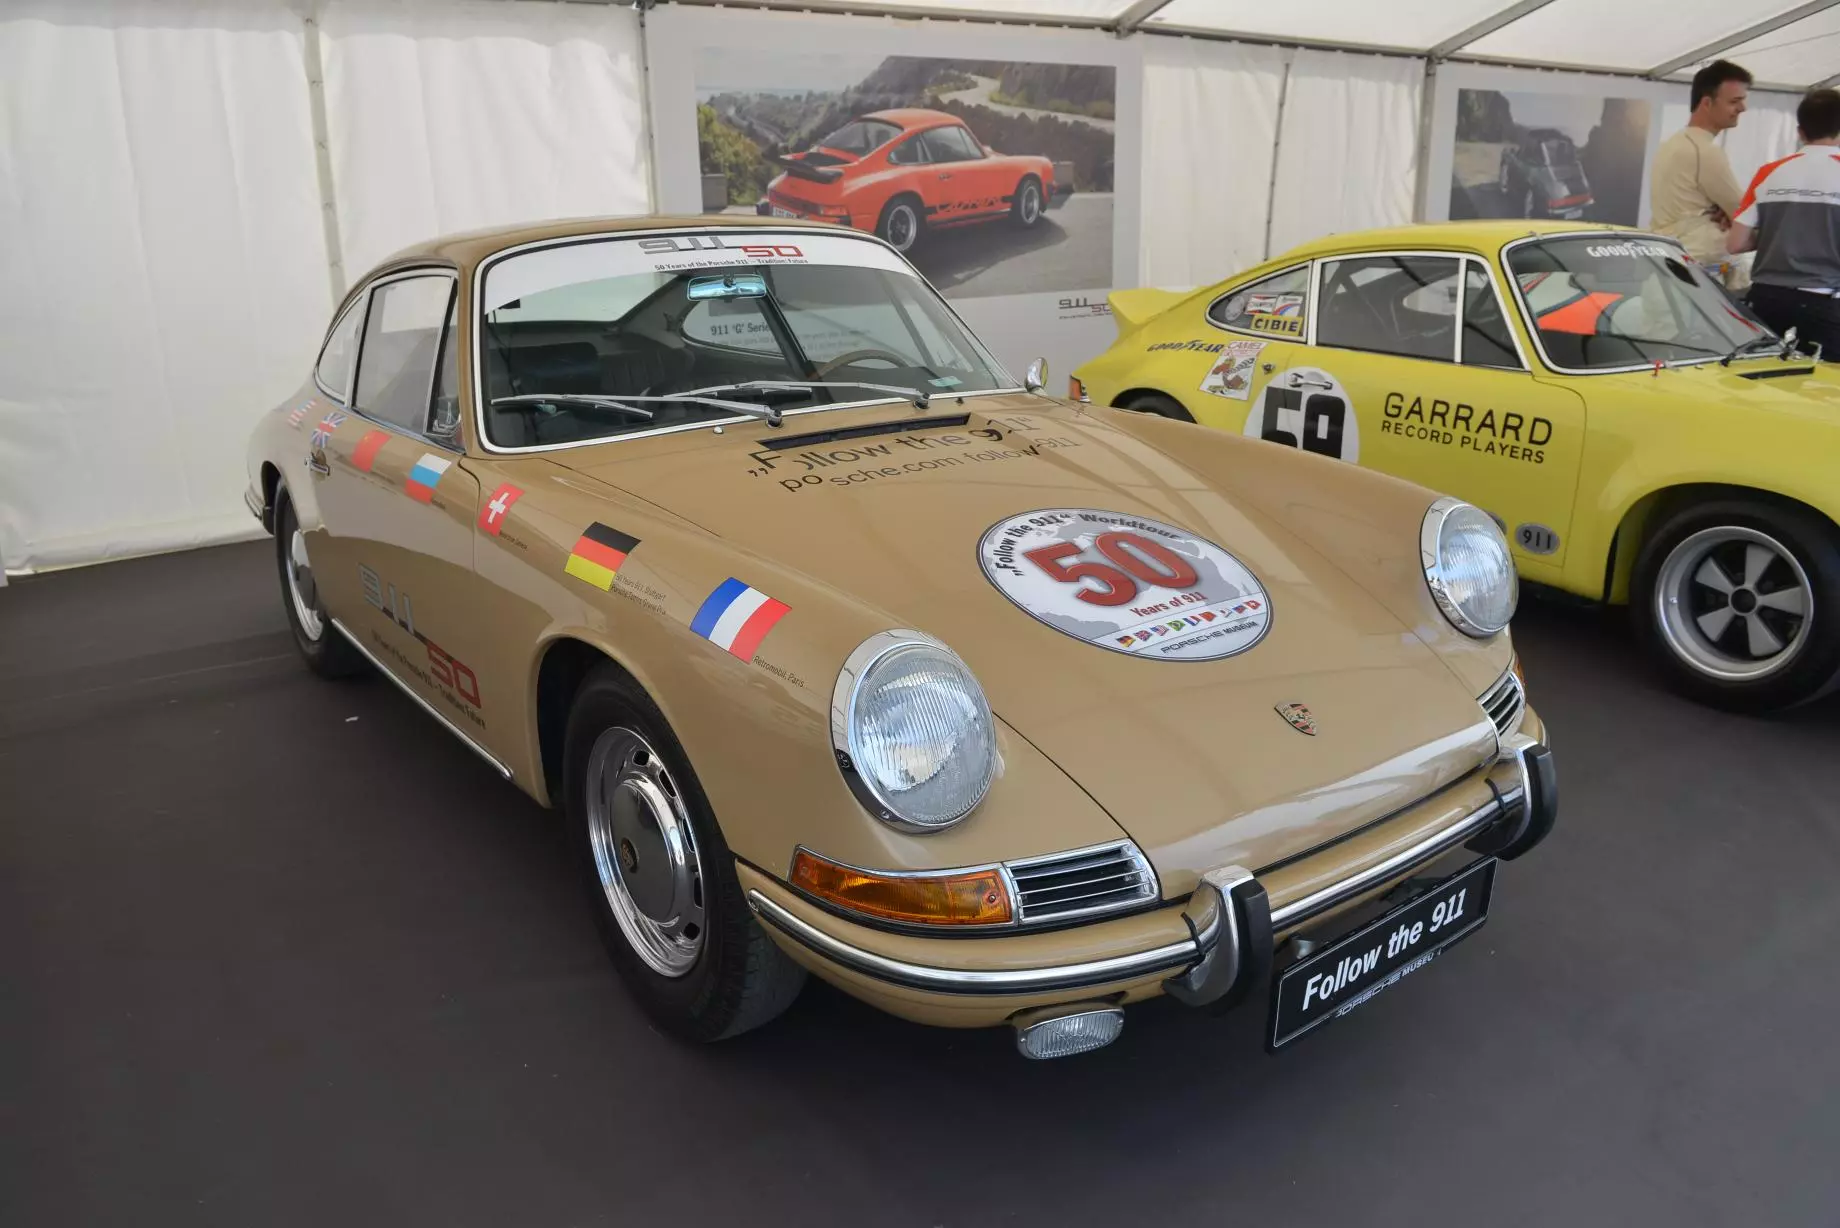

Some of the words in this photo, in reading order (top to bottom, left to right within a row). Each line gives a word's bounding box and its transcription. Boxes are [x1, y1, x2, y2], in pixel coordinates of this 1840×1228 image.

[638, 236, 726, 254] 911
[741, 246, 804, 258] 50
[696, 260, 707, 268] the
[708, 259, 735, 267] Porsche
[710, 322, 729, 336] 911
[1254, 317, 1298, 332] CIBIE
[1384, 392, 1552, 446] GARRARD
[895, 432, 972, 451] the
[1381, 420, 1453, 445] RECORD
[1460, 435, 1544, 464] PLAYERS
[1013, 521, 1033, 538] the
[1078, 513, 1184, 540] Worldtour
[1522, 529, 1551, 549] 911
[1022, 531, 1198, 607] 50
[1130, 602, 1170, 617] Years
[1169, 596, 1183, 608] of
[1184, 591, 1207, 604] 911
[1160, 630, 1223, 653] PORSCHE
[1222, 621, 1258, 637] MUSEUM
[426, 640, 482, 710] 50
[787, 673, 805, 688] Paris
[1302, 945, 1382, 1012] Follow
[1387, 920, 1424, 959] the
[1429, 888, 1467, 933] 911
[1401, 948, 1441, 977] MUSEU
